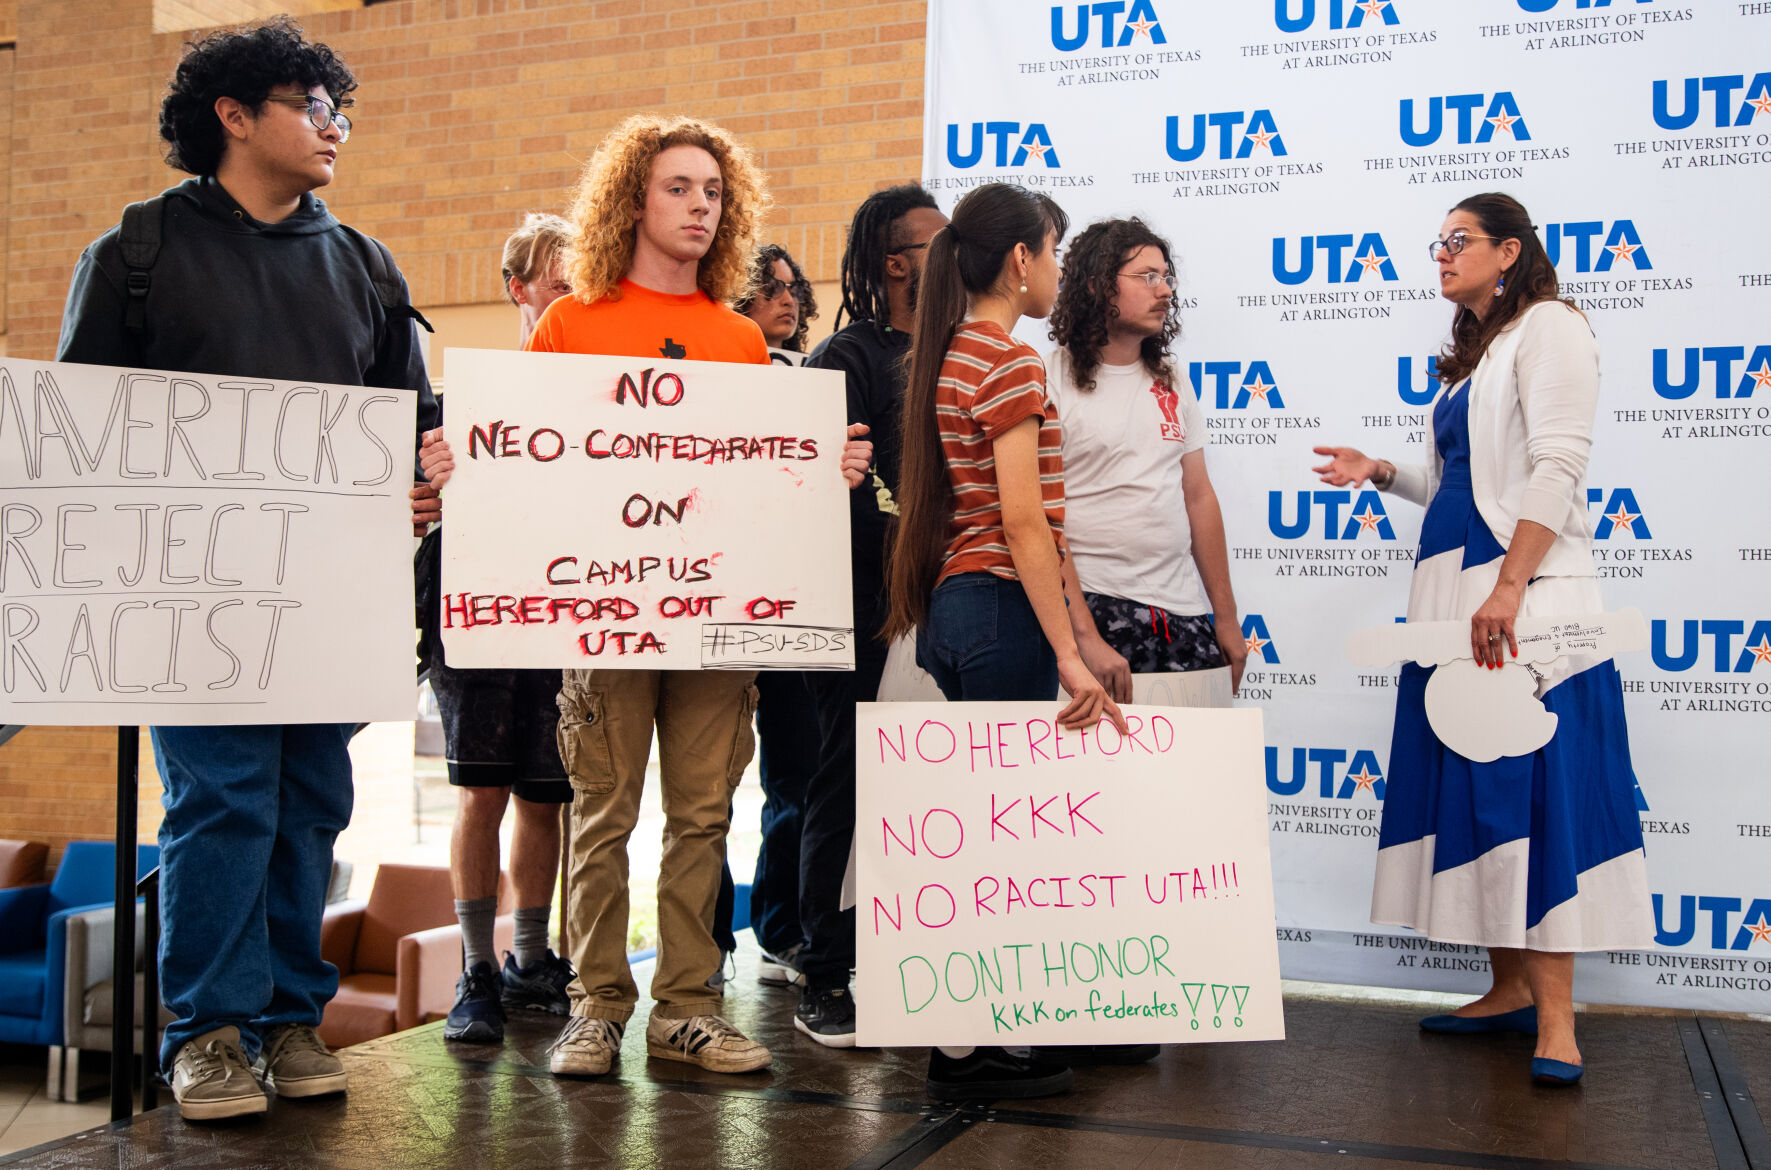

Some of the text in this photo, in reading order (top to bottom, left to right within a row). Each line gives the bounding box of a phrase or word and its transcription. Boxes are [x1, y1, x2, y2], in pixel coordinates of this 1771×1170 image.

[1739, 2, 1771, 16] THE
[1051, 0, 1167, 52] UTA
[1480, 9, 1693, 38] THE UNIVERSITY OF TEXAS
[1240, 31, 1437, 56] THE UNIVERSITY OF TEXAS
[1525, 30, 1645, 51] AT ARLINGTON
[1019, 50, 1201, 74] THE UNIVERSITY OF TEXAS
[1282, 50, 1393, 69] AT ARLINGTON
[1057, 70, 1160, 86] AT ARLINGTON
[1653, 72, 1771, 131] UTA
[1400, 91, 1532, 147] UTA
[947, 121, 1061, 168] UTA
[1166, 109, 1288, 162] UTA
[1615, 143, 1646, 155] THE
[1652, 134, 1752, 152] UNIVERSITY
[1364, 147, 1569, 171] THE UNIVERSITY OF TEXAS
[1662, 151, 1771, 169] AT ARLINGTO
[1132, 162, 1323, 184] THE UNIVERSITY OF TEXAS
[1408, 167, 1523, 184] AT ARLINGTON
[926, 179, 941, 190] HE
[1028, 175, 1047, 186] OF
[1051, 176, 1094, 187] TEXAS
[1173, 181, 1280, 198] AT ARLINGTON
[1272, 233, 1399, 285] UTA
[1557, 278, 1692, 294] ERSITY OF TEXAS
[1739, 274, 1771, 287] THE
[1238, 289, 1436, 307] THE UNIVERSITY OF TEXAS
[1580, 297, 1644, 310] INGTON
[1280, 307, 1391, 322] AT ARLINGTON
[1653, 345, 1771, 400] UTA
[616, 368, 685, 408] NO
[1206, 417, 1321, 428] RSITY OF TEXAS
[1362, 415, 1392, 427] THE
[1614, 410, 1646, 422] THE
[1652, 407, 1752, 421] UNIVERSITY
[1209, 434, 1277, 445] LINGTON
[1406, 432, 1426, 443] AT
[1662, 424, 1771, 438] AT ARLINGTO
[469, 420, 818, 464] NEO-CONFEDARATES
[622, 493, 689, 528] ON
[1269, 491, 1396, 540] UTA
[0, 503, 309, 593] REJECT
[1233, 548, 1414, 561] THE UNIVERSITY OF TEX
[1615, 549, 1635, 561] OF
[1641, 549, 1692, 560] TEXAS
[1739, 549, 1771, 560] THE
[546, 556, 713, 585] CAMPUS
[1275, 566, 1388, 577] AT ARLINGTON
[442, 593, 797, 629] HEREFORD OUT OF
[2, 599, 302, 693] RACIST
[579, 632, 667, 656] UTA
[1651, 620, 1771, 673] UTA
[1246, 672, 1316, 685] OF TEXAS
[1358, 676, 1389, 687] THE
[1623, 681, 1645, 692] HE
[1651, 682, 1751, 694] UNIVERSITY
[1660, 699, 1771, 712] AT ARLINGTO
[877, 720, 956, 764] NO
[1264, 746, 1387, 800] UTA
[1357, 809, 1376, 820] OF
[882, 792, 1104, 858] NO KKK
[1272, 821, 1380, 837] AT ARLINGTON
[1640, 820, 1690, 834] TEXAS
[1737, 824, 1771, 837] THE
[874, 884, 956, 935] NO
[974, 875, 1127, 916] RACIST
[1652, 893, 1771, 951] UTA
[1275, 930, 1312, 942] EXAS
[1353, 935, 1481, 954] THE UNIVERSITY
[1396, 955, 1491, 972] AT ARLINGT
[1608, 952, 1640, 965] THE
[1647, 954, 1748, 971] UNIVERSITY
[1656, 973, 1771, 991] AT ARLINGTO
